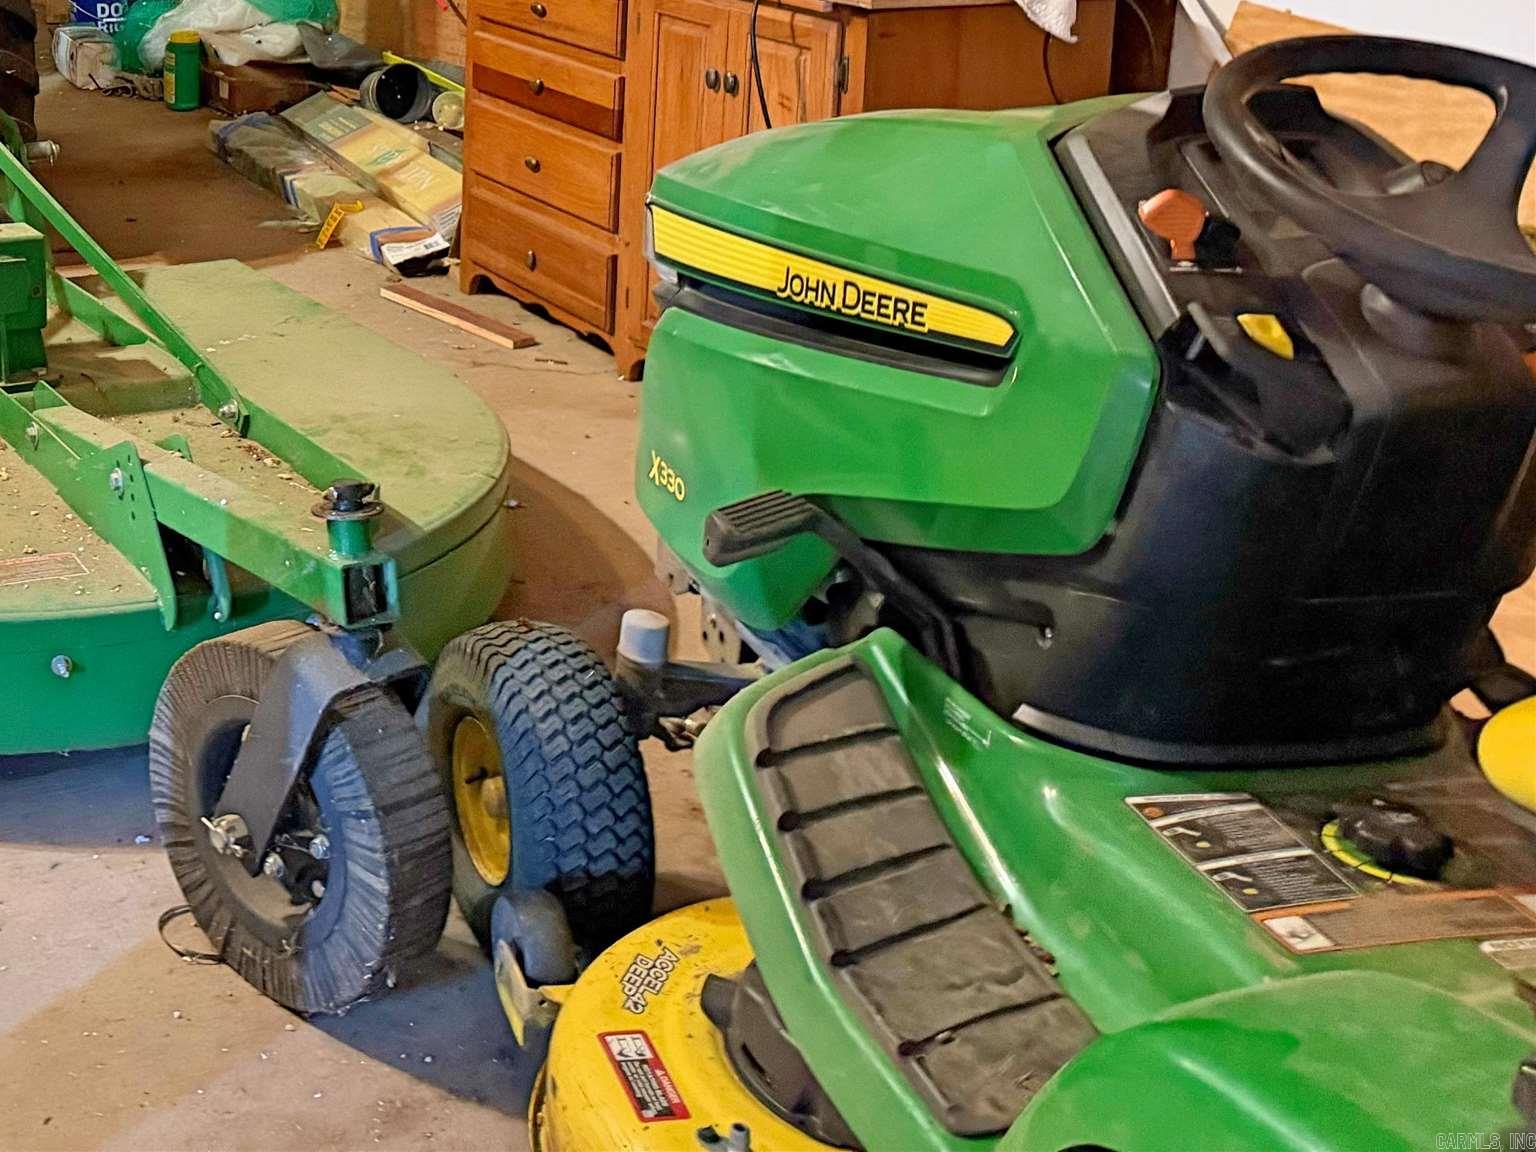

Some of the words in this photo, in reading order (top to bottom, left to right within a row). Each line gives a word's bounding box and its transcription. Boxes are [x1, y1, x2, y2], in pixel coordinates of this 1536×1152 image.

[96, 2, 123, 18] DO
[777, 265, 837, 308] JOHN
[841, 279, 929, 330] DEERE
[648, 448, 686, 502] X330
[620, 953, 655, 997] DEEP
[637, 946, 680, 996] ACCEL
